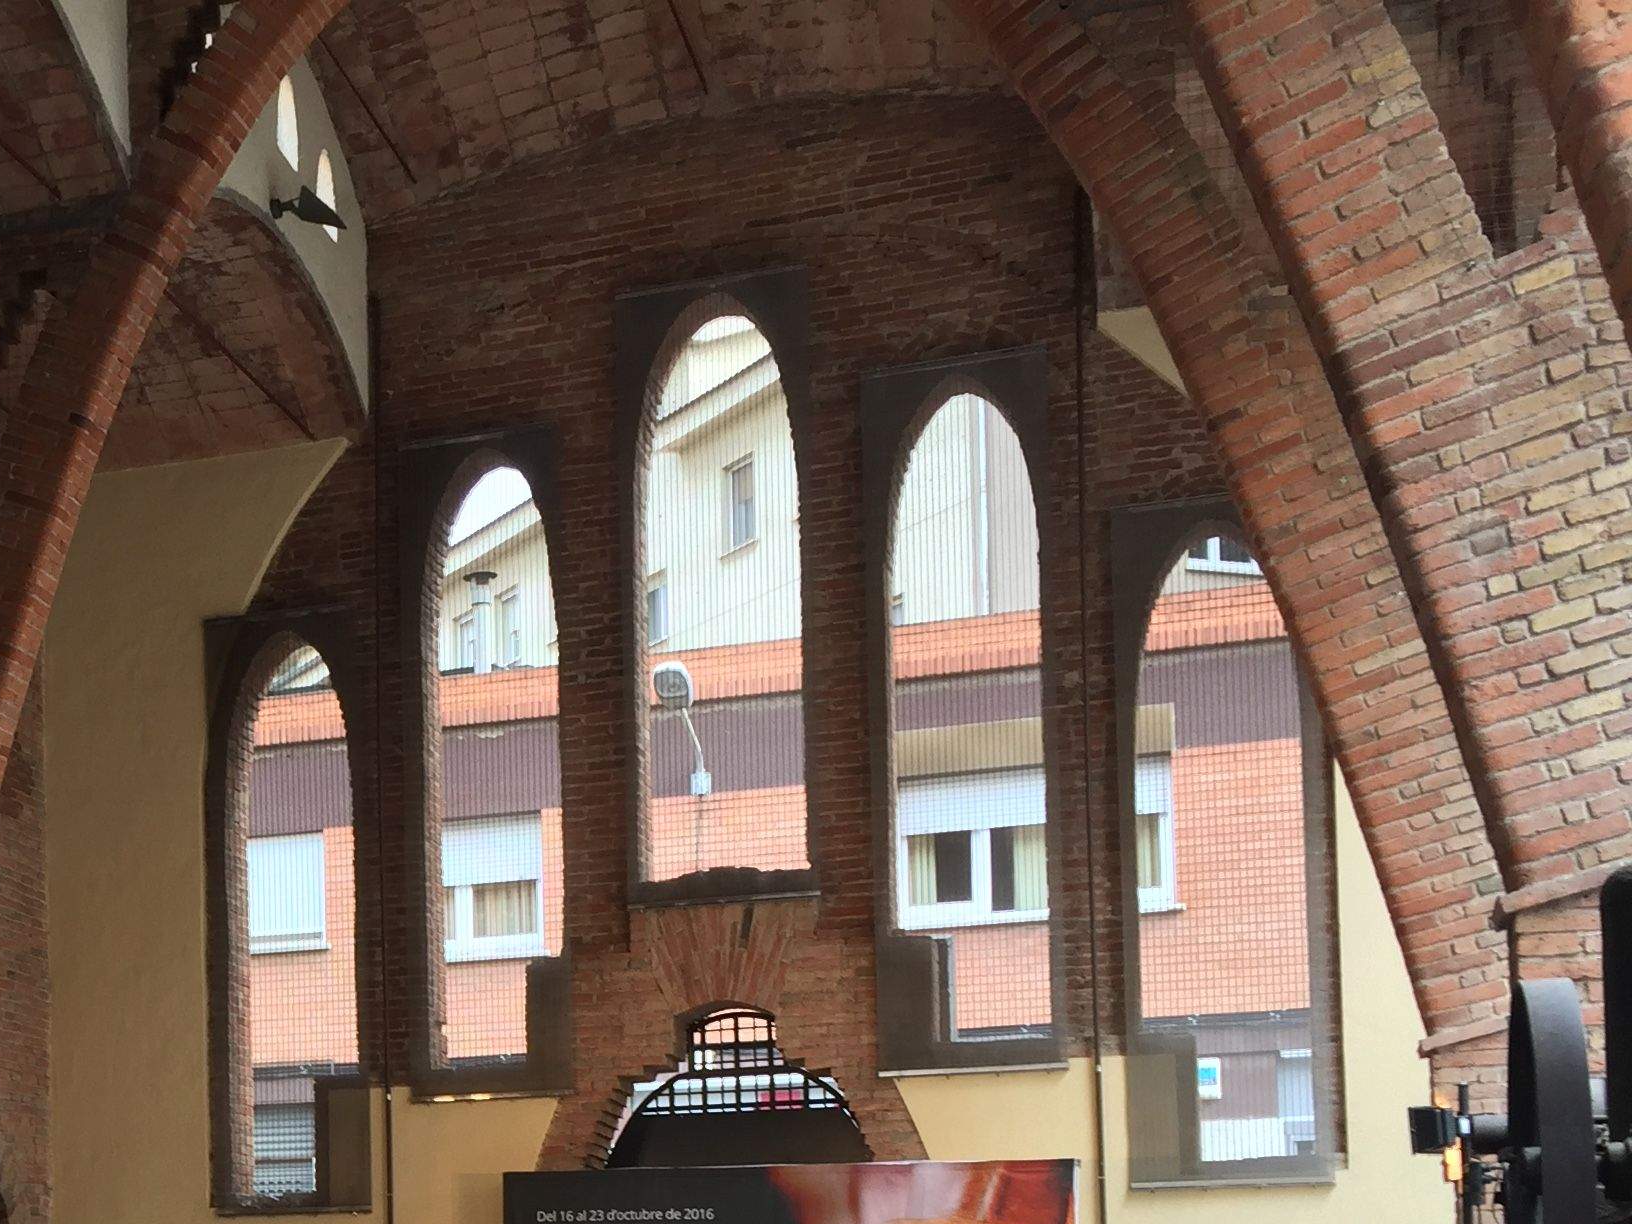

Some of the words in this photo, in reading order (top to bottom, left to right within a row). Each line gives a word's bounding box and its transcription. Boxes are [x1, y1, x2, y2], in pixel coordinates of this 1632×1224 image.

[536, 1210, 556, 1222] Del
[560, 1210, 574, 1222] 16
[576, 1209, 587, 1221] al
[588, 1209, 605, 1221] 23
[606, 1208, 663, 1221] d'octubre
[664, 1208, 681, 1220] de
[684, 1207, 715, 1220] 2016
